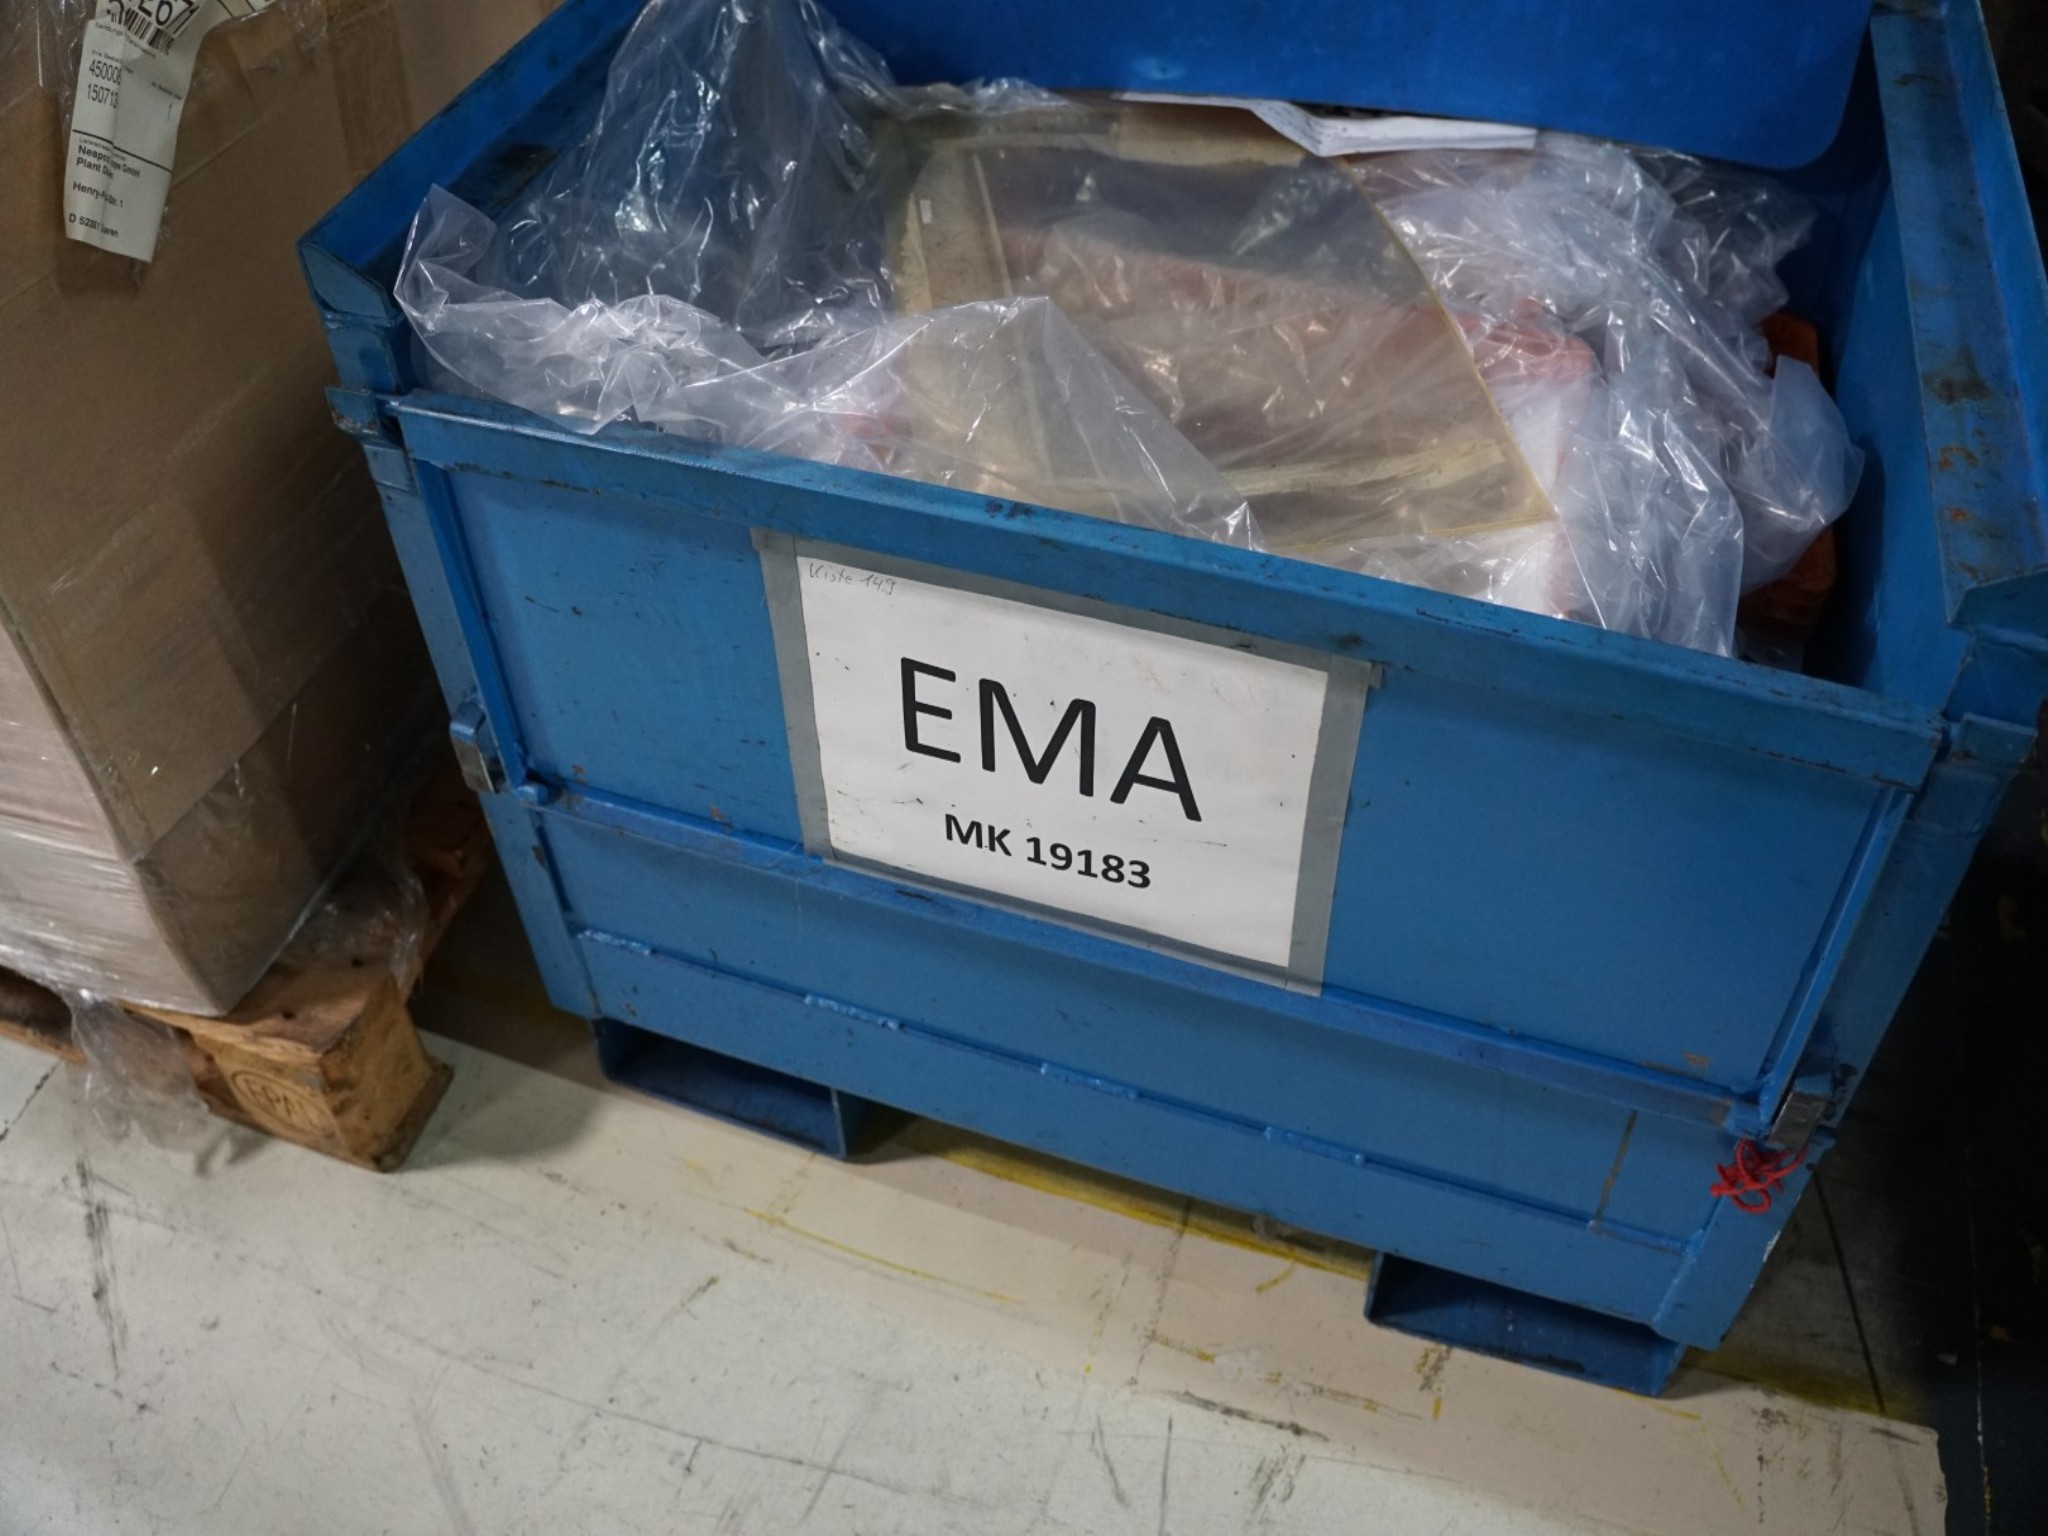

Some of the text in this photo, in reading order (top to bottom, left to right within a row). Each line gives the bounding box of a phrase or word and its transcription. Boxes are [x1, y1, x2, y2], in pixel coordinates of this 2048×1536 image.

[76, 157, 101, 173] Plant
[69, 212, 77, 223] D
[809, 563, 853, 585] Kiste
[901, 656, 1203, 822] EMA
[944, 814, 1152, 889] MK 19183
